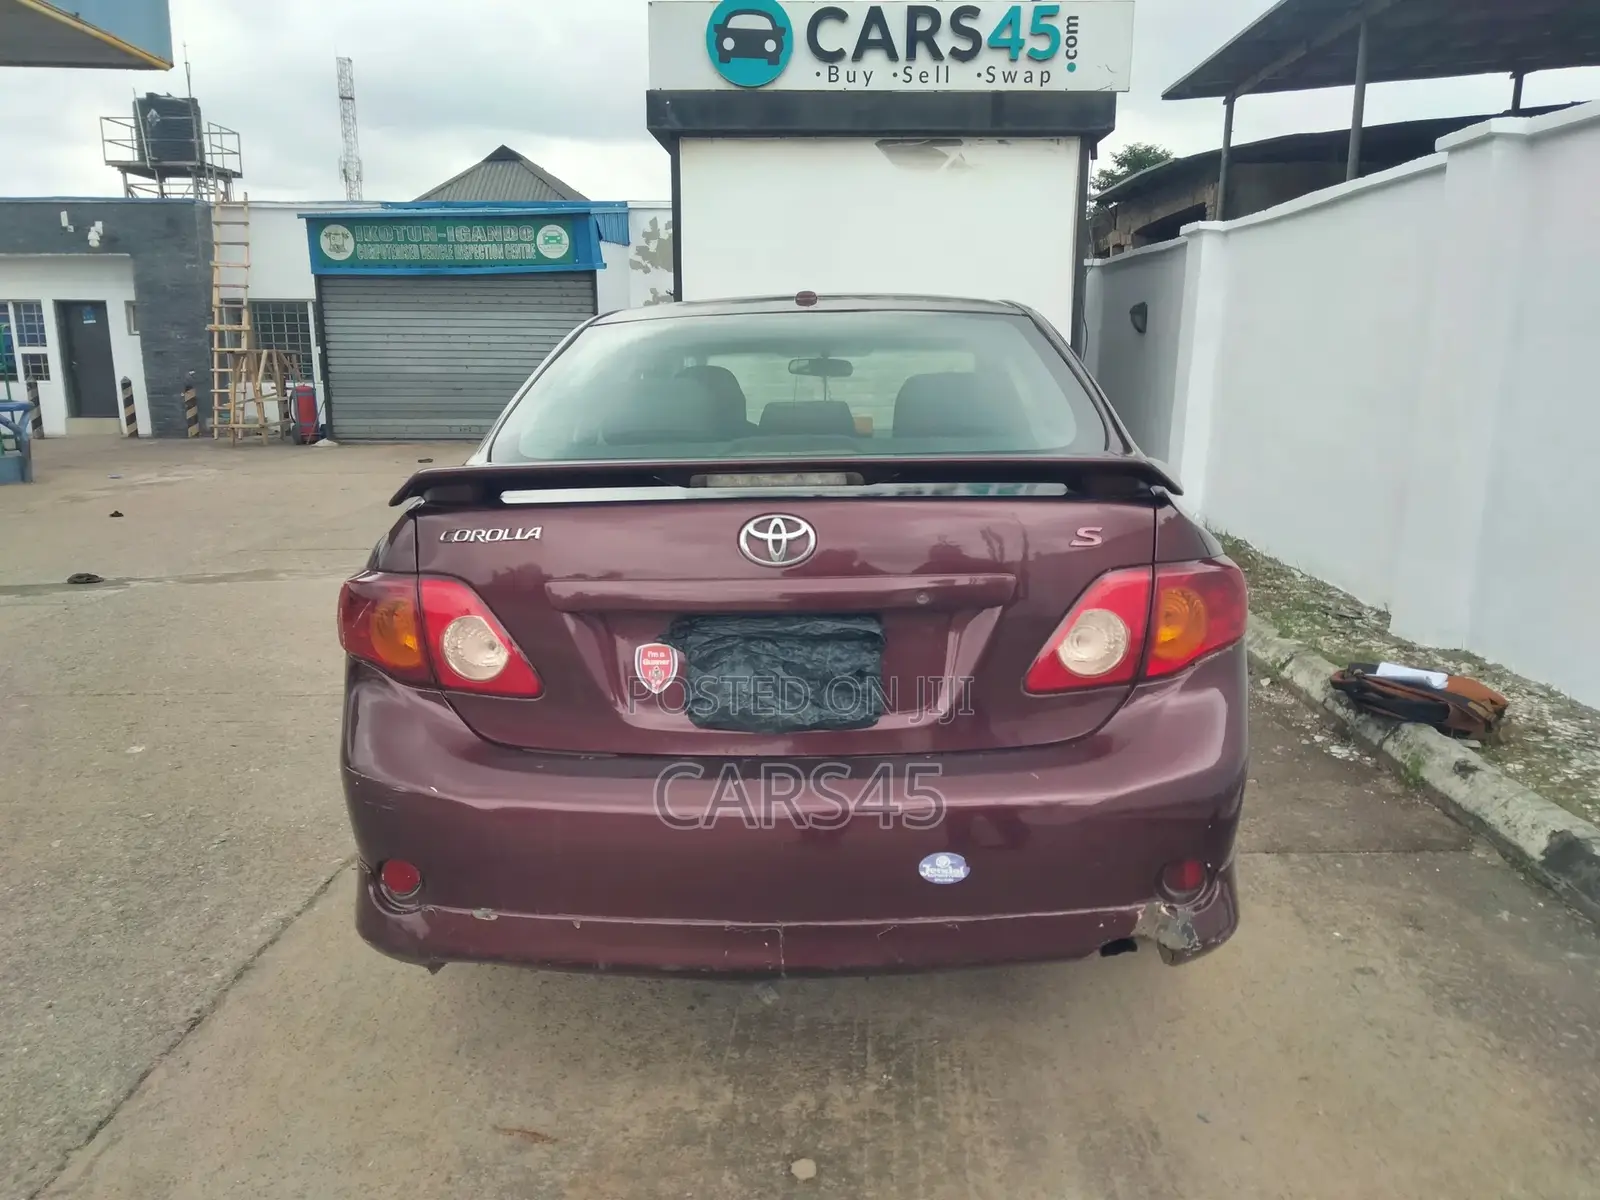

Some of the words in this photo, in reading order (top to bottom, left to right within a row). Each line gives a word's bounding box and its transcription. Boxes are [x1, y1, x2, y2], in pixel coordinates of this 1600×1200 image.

[806, 4, 1061, 63] CARS45
[354, 225, 534, 242] IKOTUN-IGANDO
[419, 243, 454, 260] VEHICLE
[454, 243, 504, 260] INSPECTION
[504, 243, 536, 260] CENTRE
[440, 526, 543, 543] COROLLA
[1069, 526, 1103, 547] S
